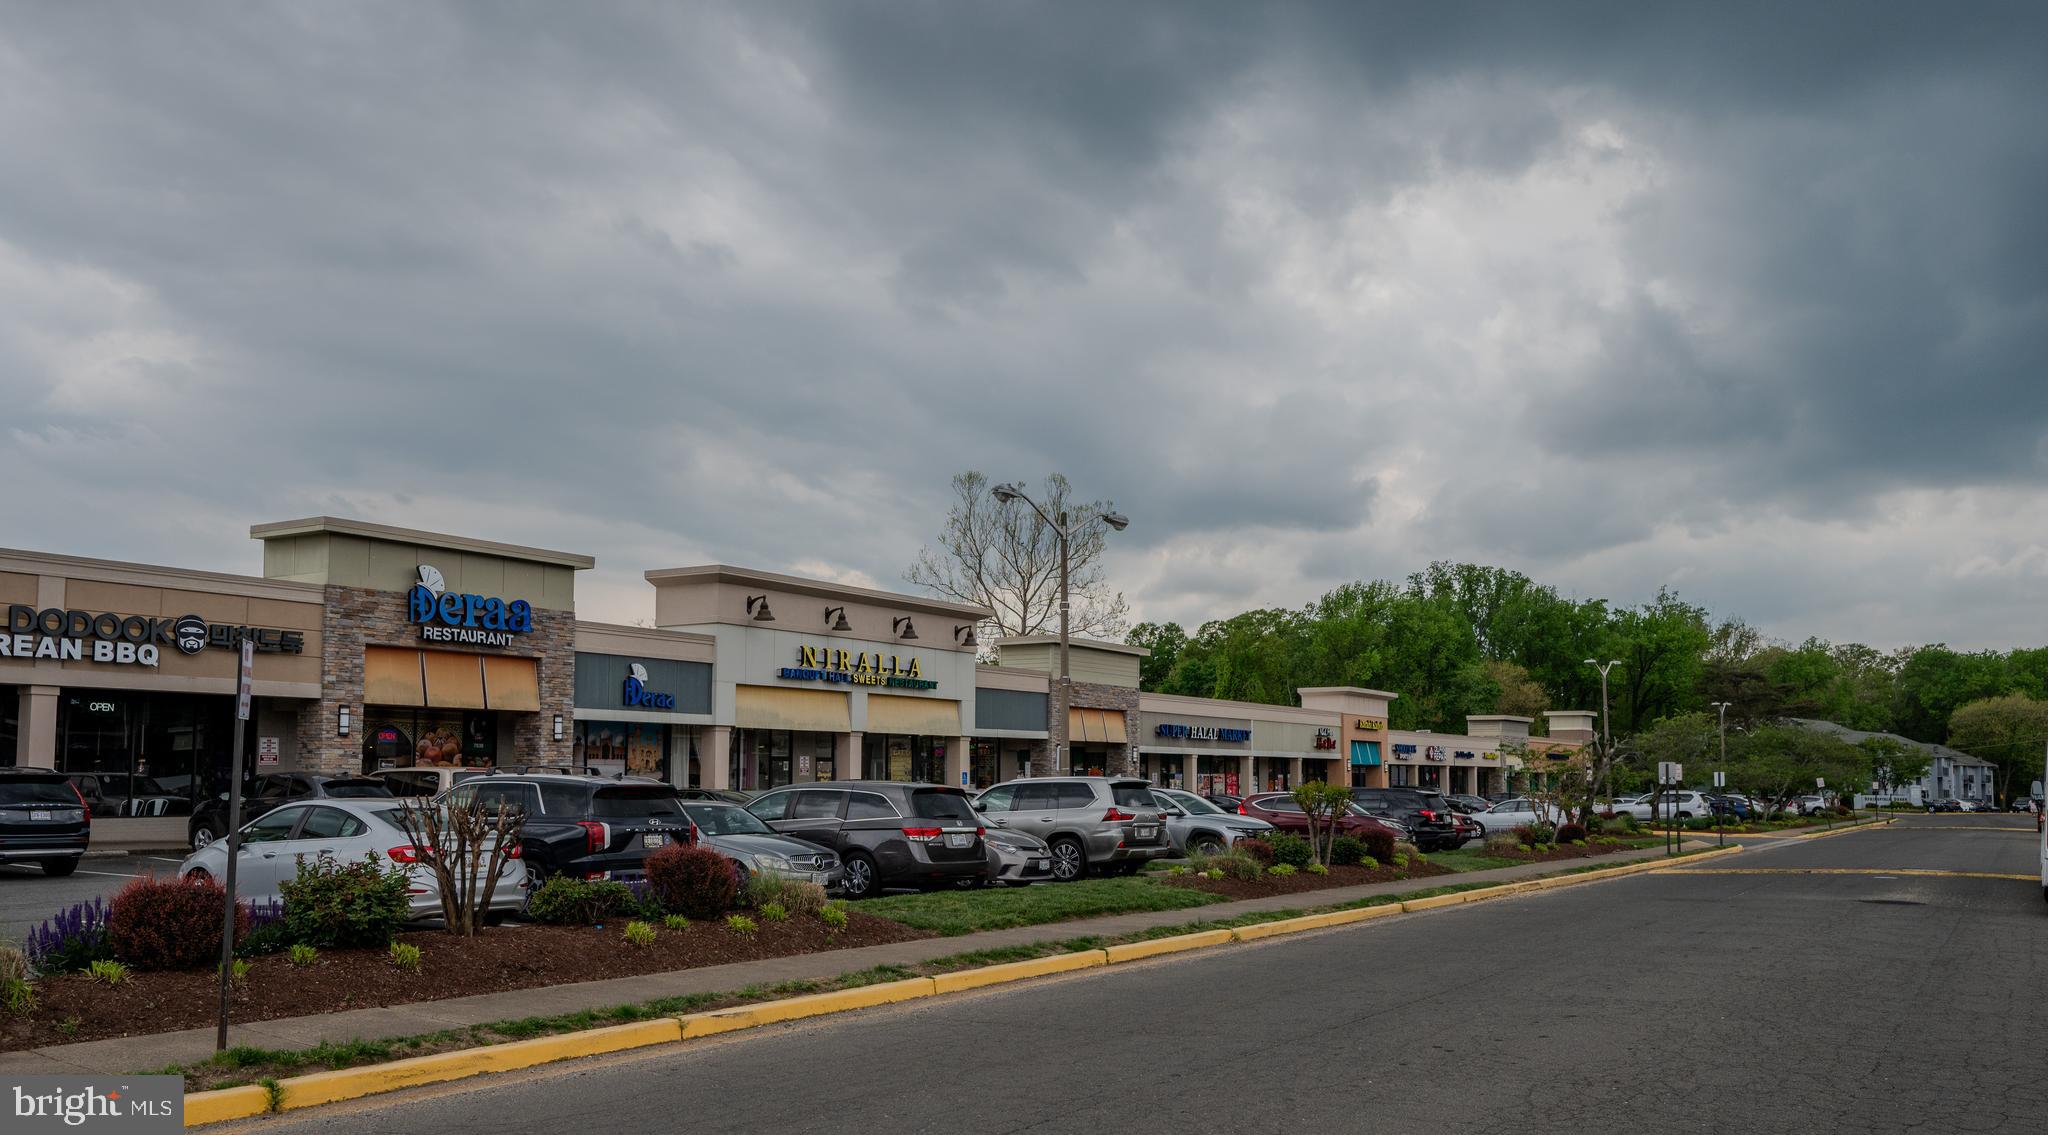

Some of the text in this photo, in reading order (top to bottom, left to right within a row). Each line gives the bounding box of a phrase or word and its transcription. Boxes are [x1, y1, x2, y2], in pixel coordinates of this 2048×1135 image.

[10, 605, 174, 646] DODOOK
[422, 626, 515, 648] RESTAURANT
[94, 640, 159, 668] BBQ
[800, 644, 922, 678] NIRALLA
[853, 673, 887, 687] SWEETS
[887, 677, 938, 690] RESTAURANT
[89, 702, 115, 712] OPEN
[1158, 724, 1190, 738] SUPER
[1190, 726, 1219, 740] HALAL
